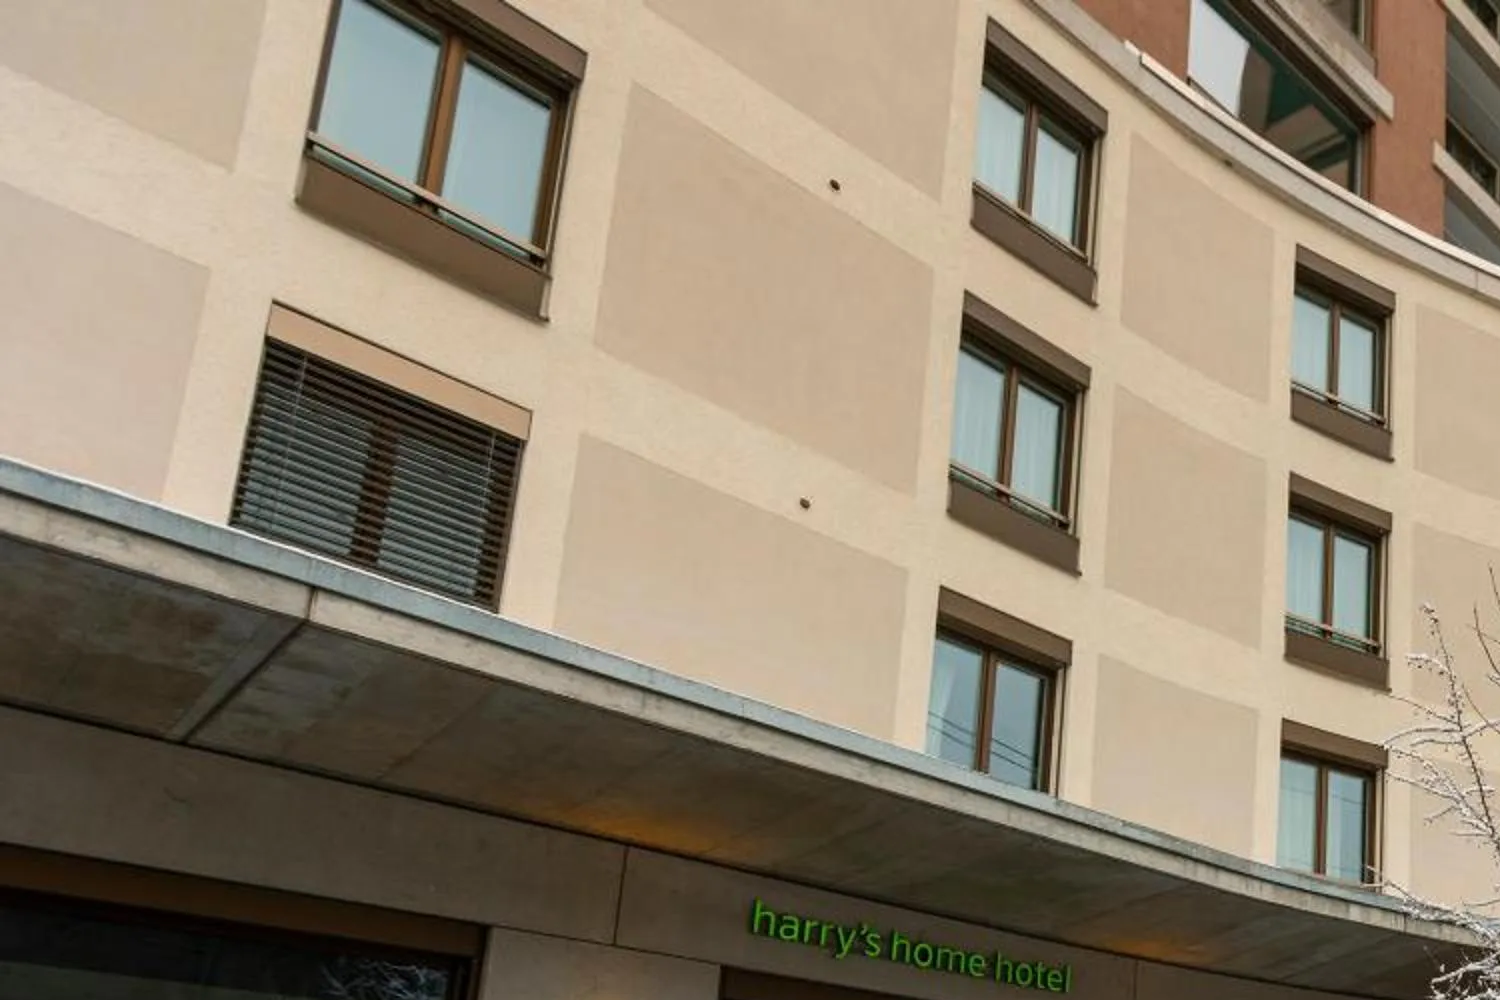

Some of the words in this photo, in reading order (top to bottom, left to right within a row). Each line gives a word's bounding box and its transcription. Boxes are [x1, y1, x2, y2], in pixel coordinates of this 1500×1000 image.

[752, 897, 881, 960] harry's
[890, 930, 986, 977] home
[993, 950, 1073, 993] hotel
